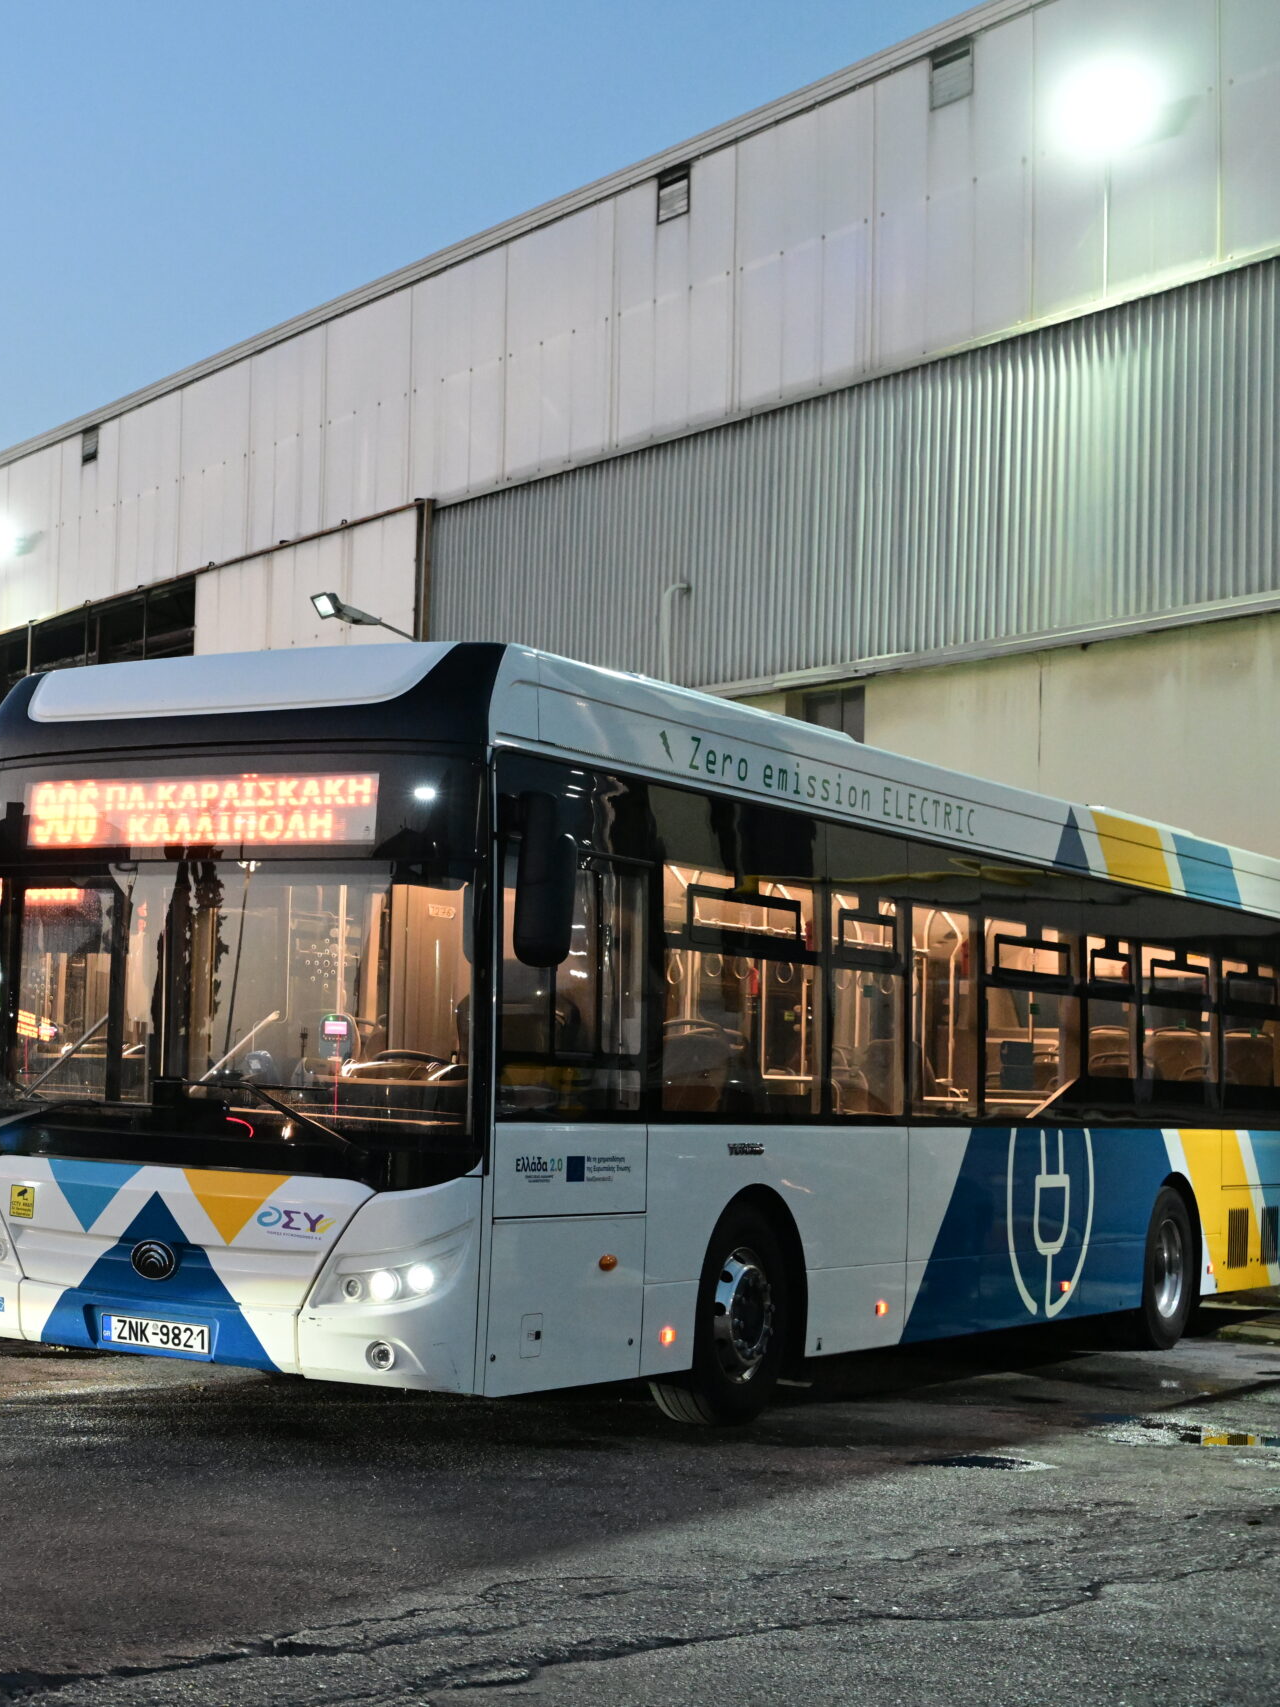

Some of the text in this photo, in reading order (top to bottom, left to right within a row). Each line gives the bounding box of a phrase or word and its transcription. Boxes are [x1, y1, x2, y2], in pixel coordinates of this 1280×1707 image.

[688, 736, 975, 837] Zero emission ELECTRIC
[515, 1156, 563, 1172] Ελλάδα 2.0
[256, 1206, 325, 1233] ΟΣΥ
[116, 1318, 205, 1351] ZNK-9821
